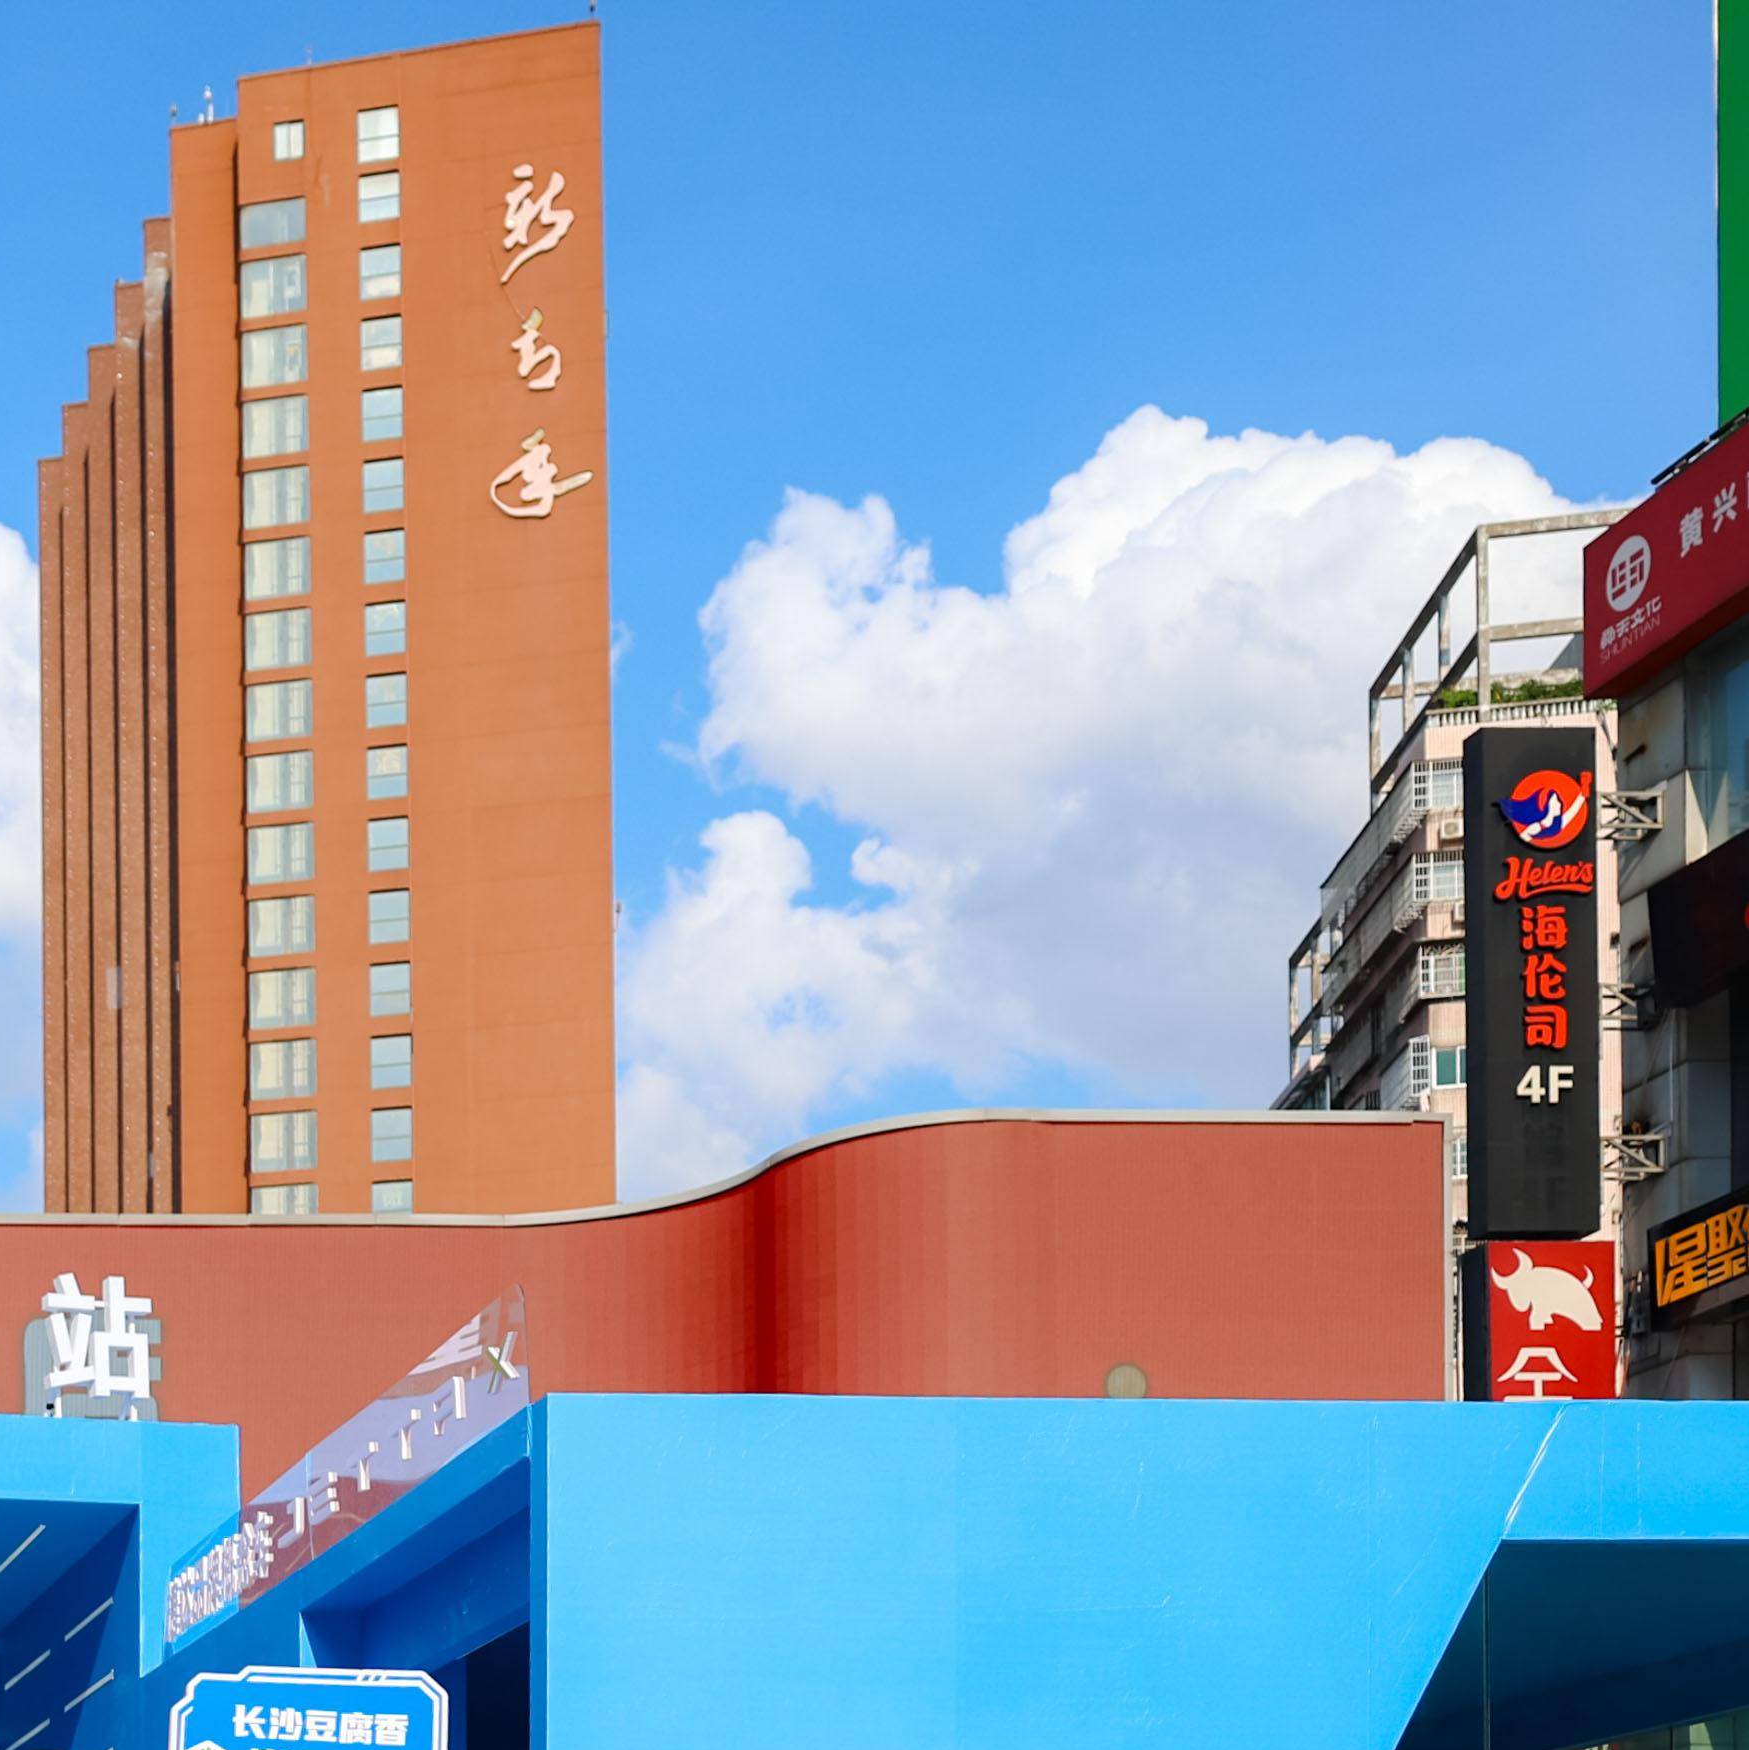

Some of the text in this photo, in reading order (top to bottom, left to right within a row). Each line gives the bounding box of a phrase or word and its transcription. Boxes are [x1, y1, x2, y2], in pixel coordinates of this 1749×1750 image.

[1495, 855, 1594, 898] Helen's
[1520, 905, 1568, 1050] 海伦司
[1516, 1065, 1574, 1103] 4F
[232, 1703, 409, 1746] 长沙豆腐香
